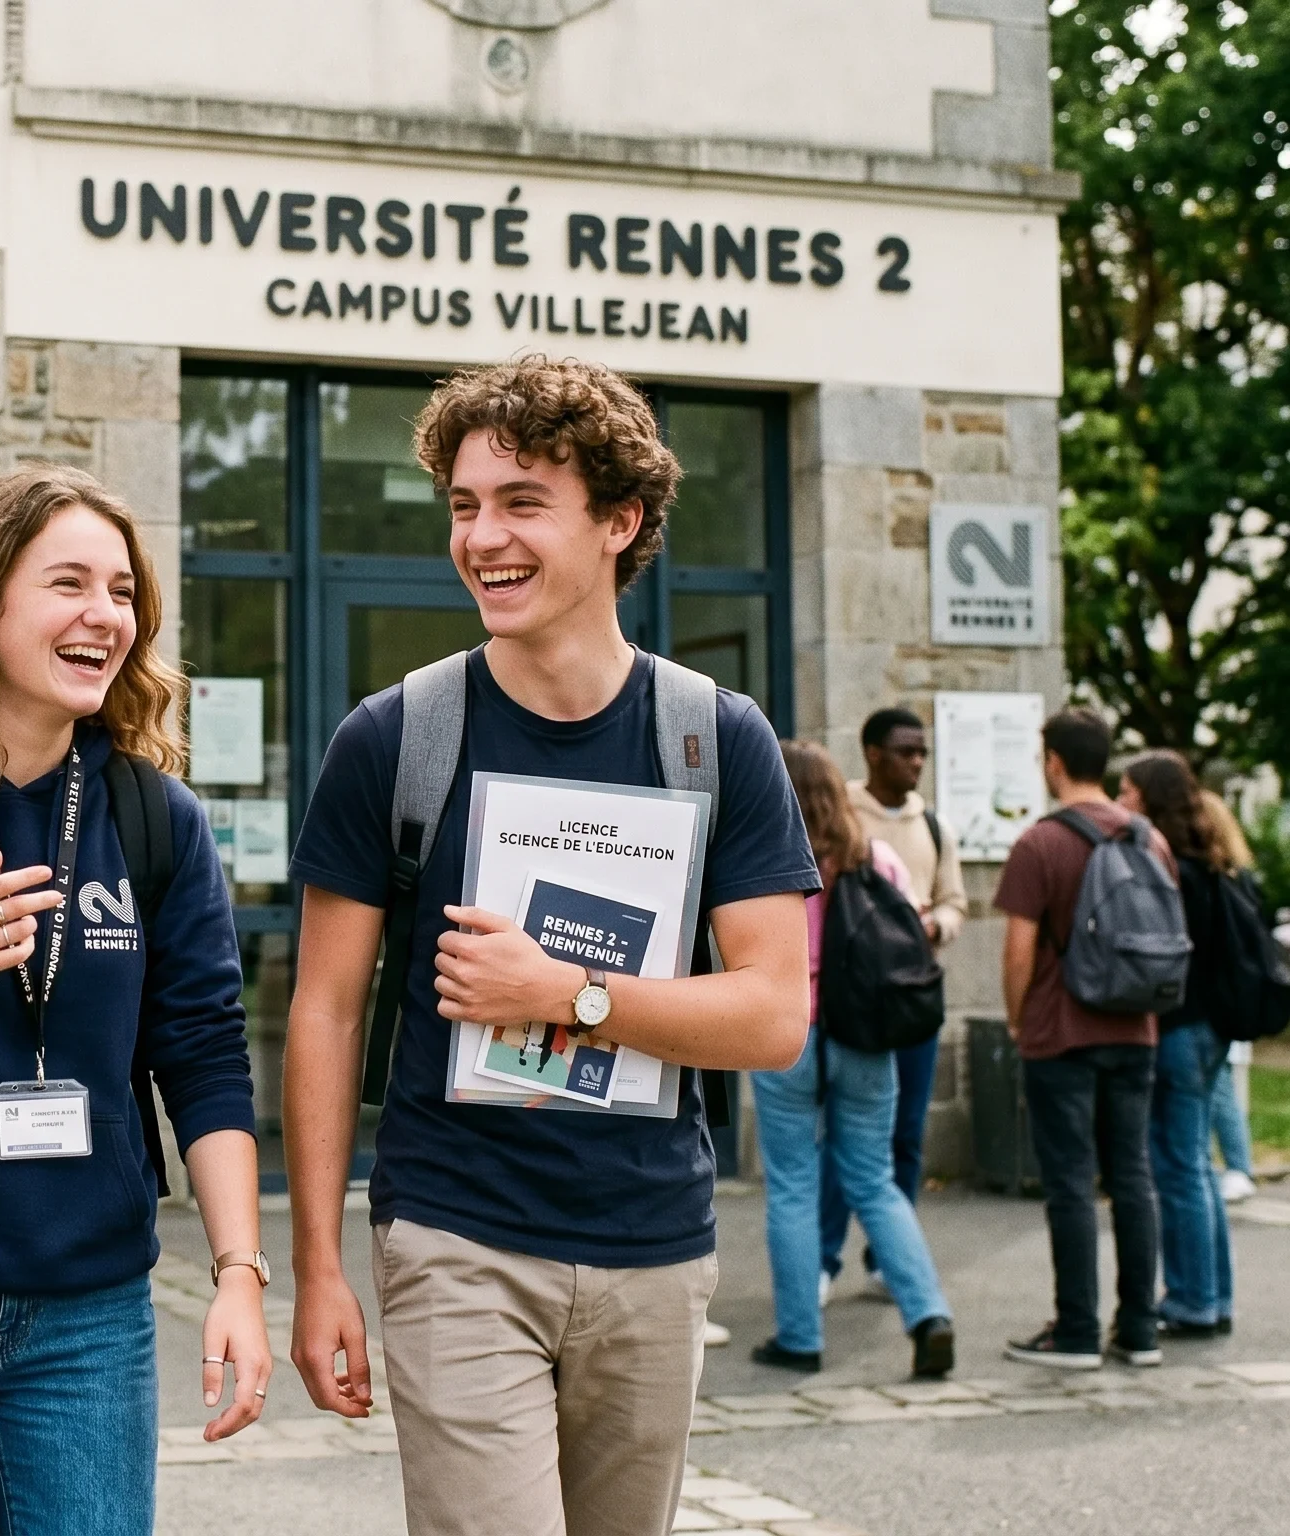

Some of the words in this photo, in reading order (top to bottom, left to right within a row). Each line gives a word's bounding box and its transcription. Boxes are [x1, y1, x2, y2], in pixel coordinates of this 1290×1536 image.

[81, 178, 530, 268] UNIVERSITÉ
[567, 213, 844, 289] RENNES
[876, 236, 911, 294] 2
[266, 278, 472, 328] CAMPUS
[495, 292, 748, 344] VILLEJEAN
[559, 820, 619, 838] LICENCE
[499, 832, 560, 850] SCIENCE
[563, 838, 582, 852] DE
[585, 840, 675, 861] L'EDUCATION
[84, 939, 130, 950] RENNES
[132, 940, 138, 951] 2
[542, 914, 605, 944] RENNES
[606, 932, 617, 947] 2
[539, 931, 627, 967] BIENVENUE
